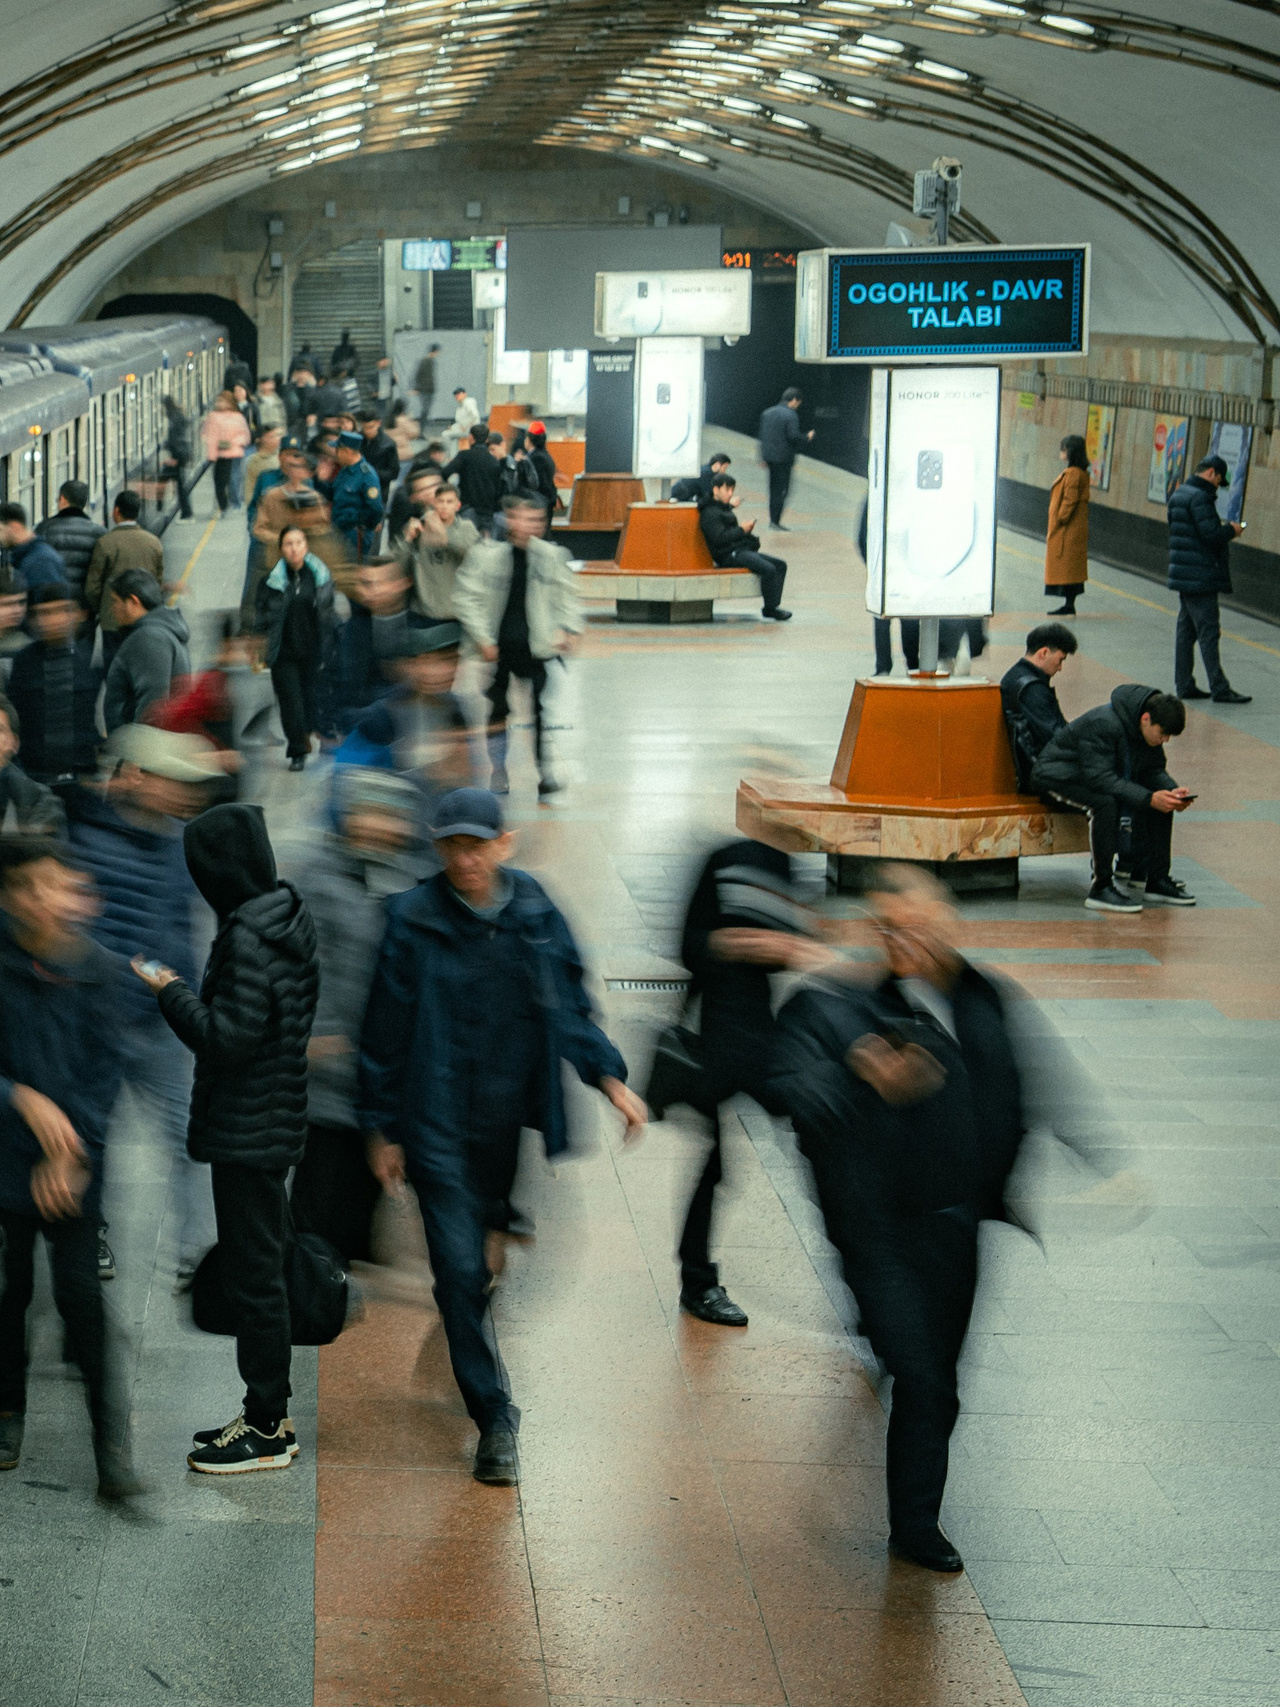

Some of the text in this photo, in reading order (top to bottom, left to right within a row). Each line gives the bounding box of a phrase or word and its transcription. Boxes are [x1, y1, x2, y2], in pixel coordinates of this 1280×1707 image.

[847, 281, 969, 305] OGOHLIK
[992, 279, 1064, 301] DAVR
[907, 305, 1002, 328] TALABI
[898, 391, 940, 400] HONOR
